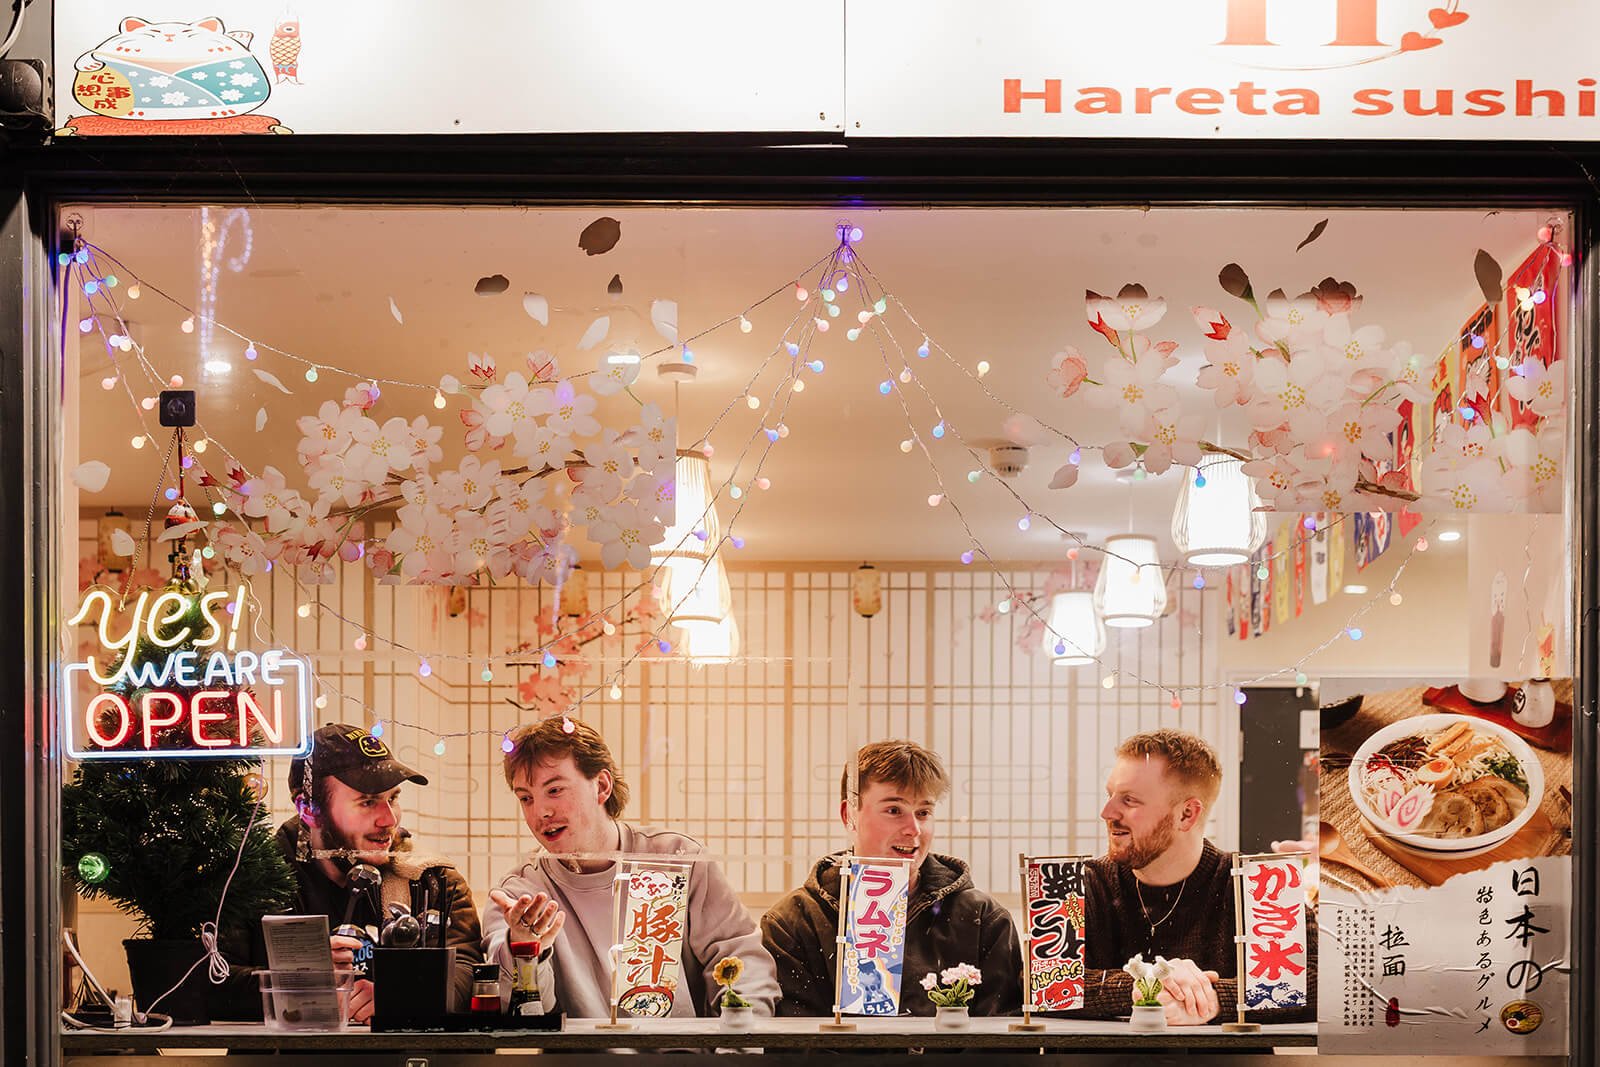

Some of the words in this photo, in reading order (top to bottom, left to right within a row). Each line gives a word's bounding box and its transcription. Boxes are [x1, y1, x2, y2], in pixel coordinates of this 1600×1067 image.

[1003, 78, 1320, 116] Hareta
[1352, 78, 1597, 117] sushi
[204, 650, 285, 686] ARE
[86, 690, 283, 749] OPEN
[626, 902, 682, 985] 豚汁
[855, 869, 893, 959] ラムネ
[1247, 863, 1306, 981] かき氷
[1378, 924, 1410, 978] 拉面
[1504, 866, 1550, 993] 日本の
[1474, 886, 1496, 1034] 特色あるグルメ
